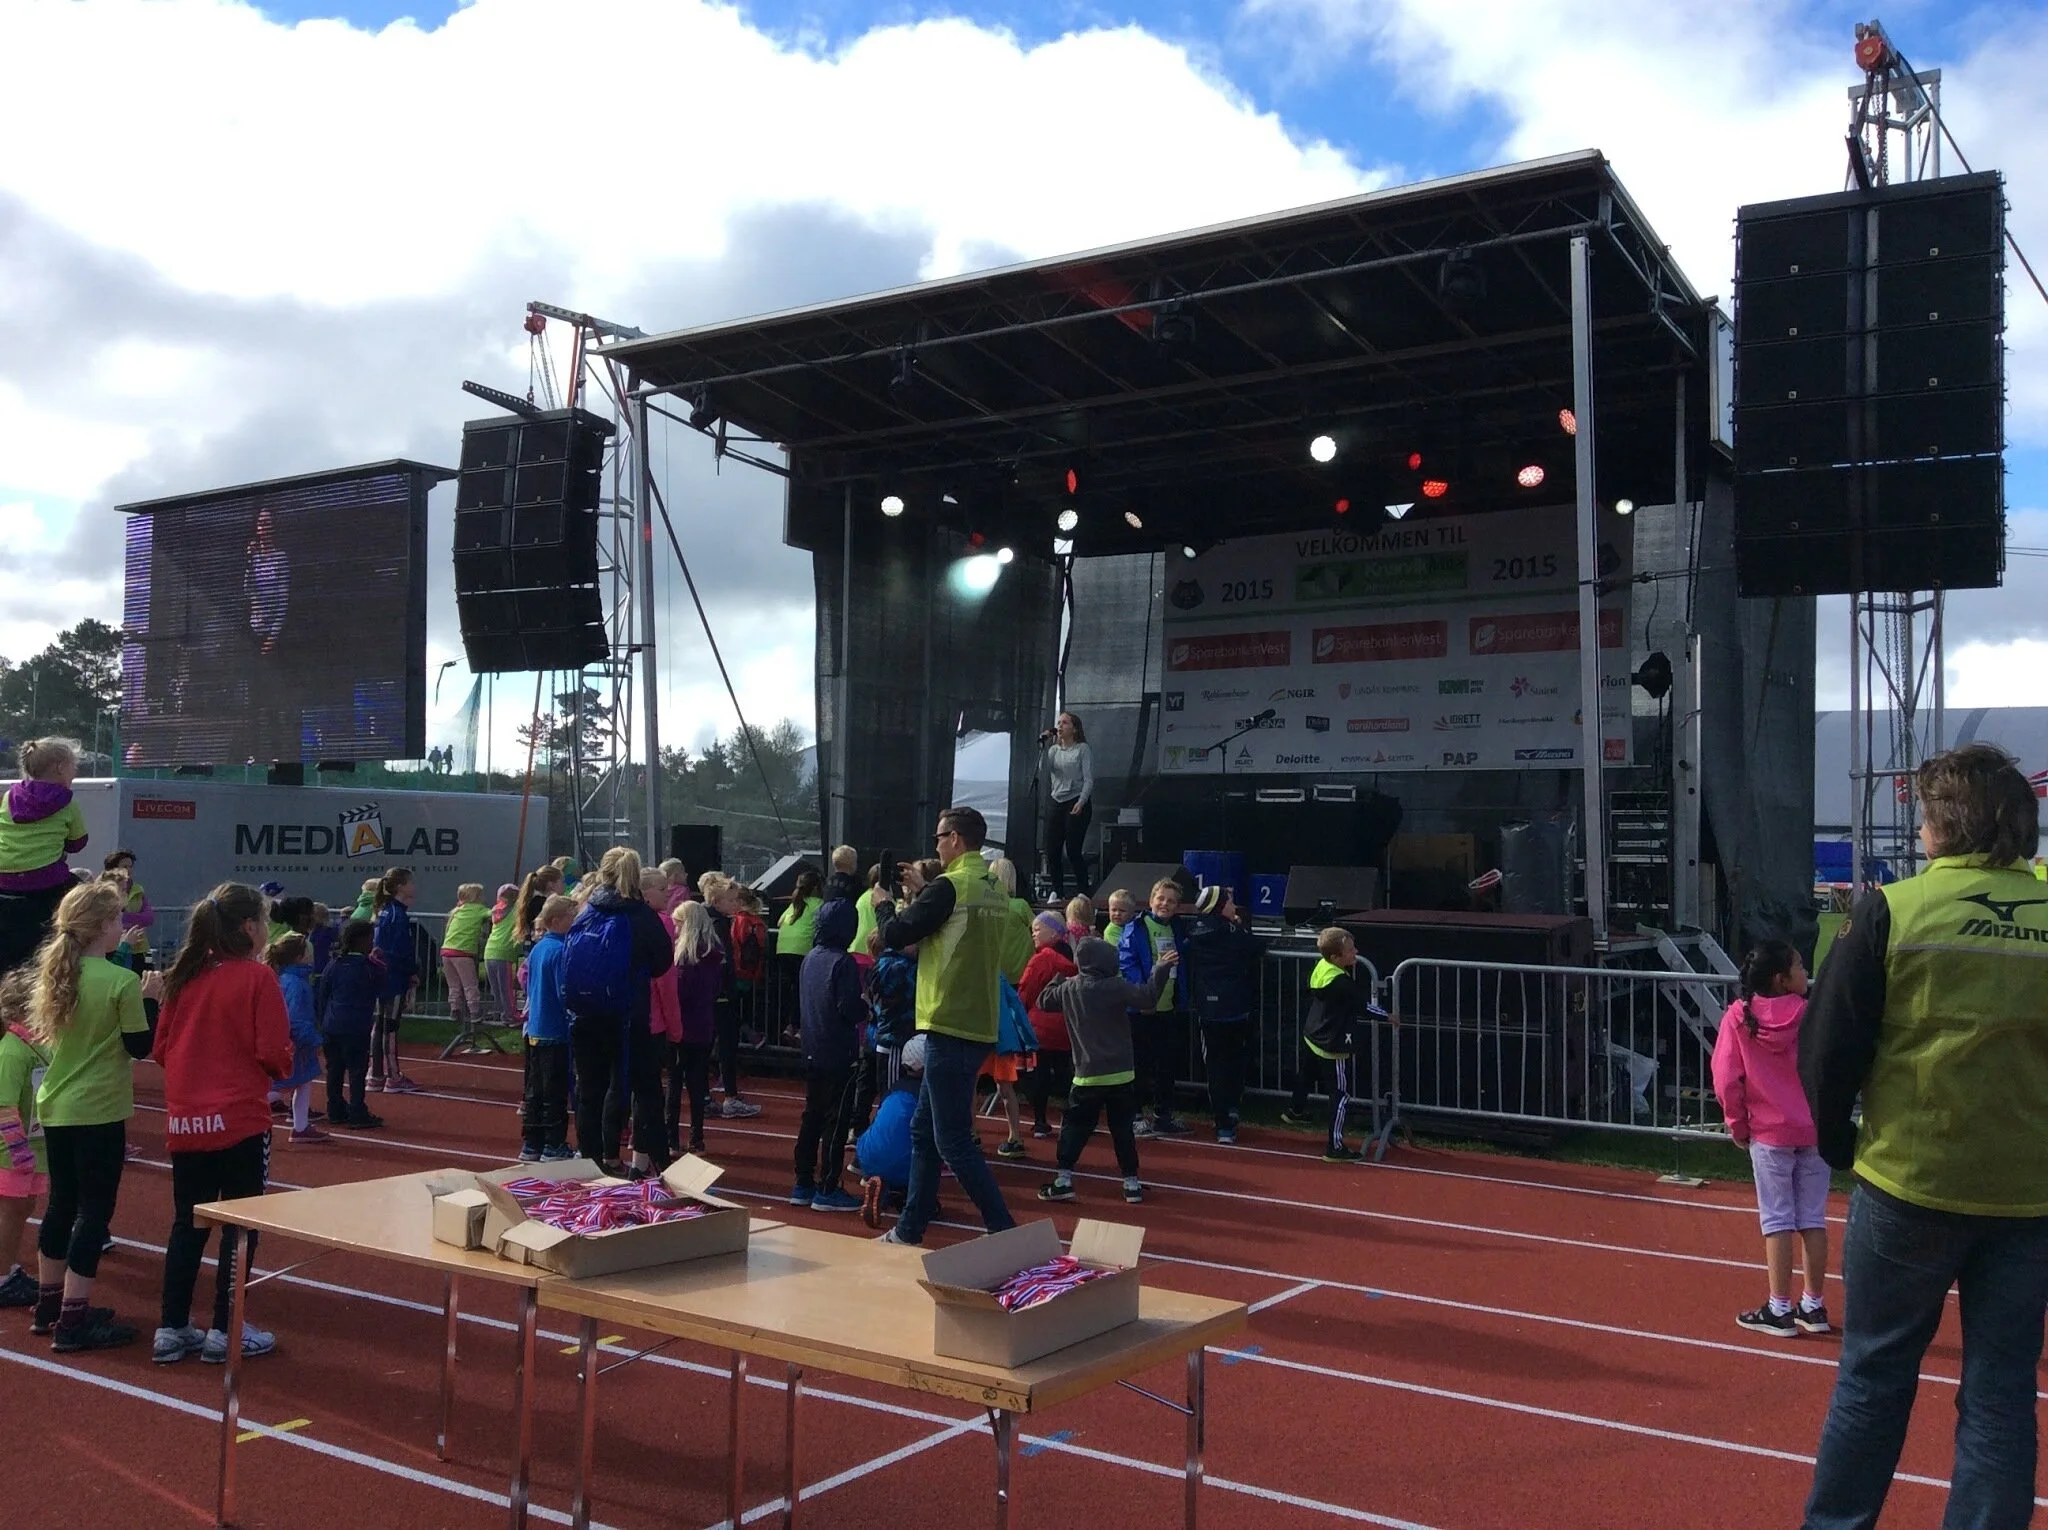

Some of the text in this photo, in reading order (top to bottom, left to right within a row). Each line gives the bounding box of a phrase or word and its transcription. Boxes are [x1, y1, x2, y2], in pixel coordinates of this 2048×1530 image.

[1296, 525, 1469, 558] VELKOMMEN TIL
[1491, 553, 1559, 581] 2015
[1221, 579, 1275, 603] 2015
[1287, 688, 1316, 699] NGIR
[1449, 713, 1481, 725] IDRETT
[1275, 754, 1321, 765] Deloitte
[1443, 752, 1479, 766] PAP
[1260, 885, 1272, 904] 2
[168, 1113, 226, 1135] MARIA
